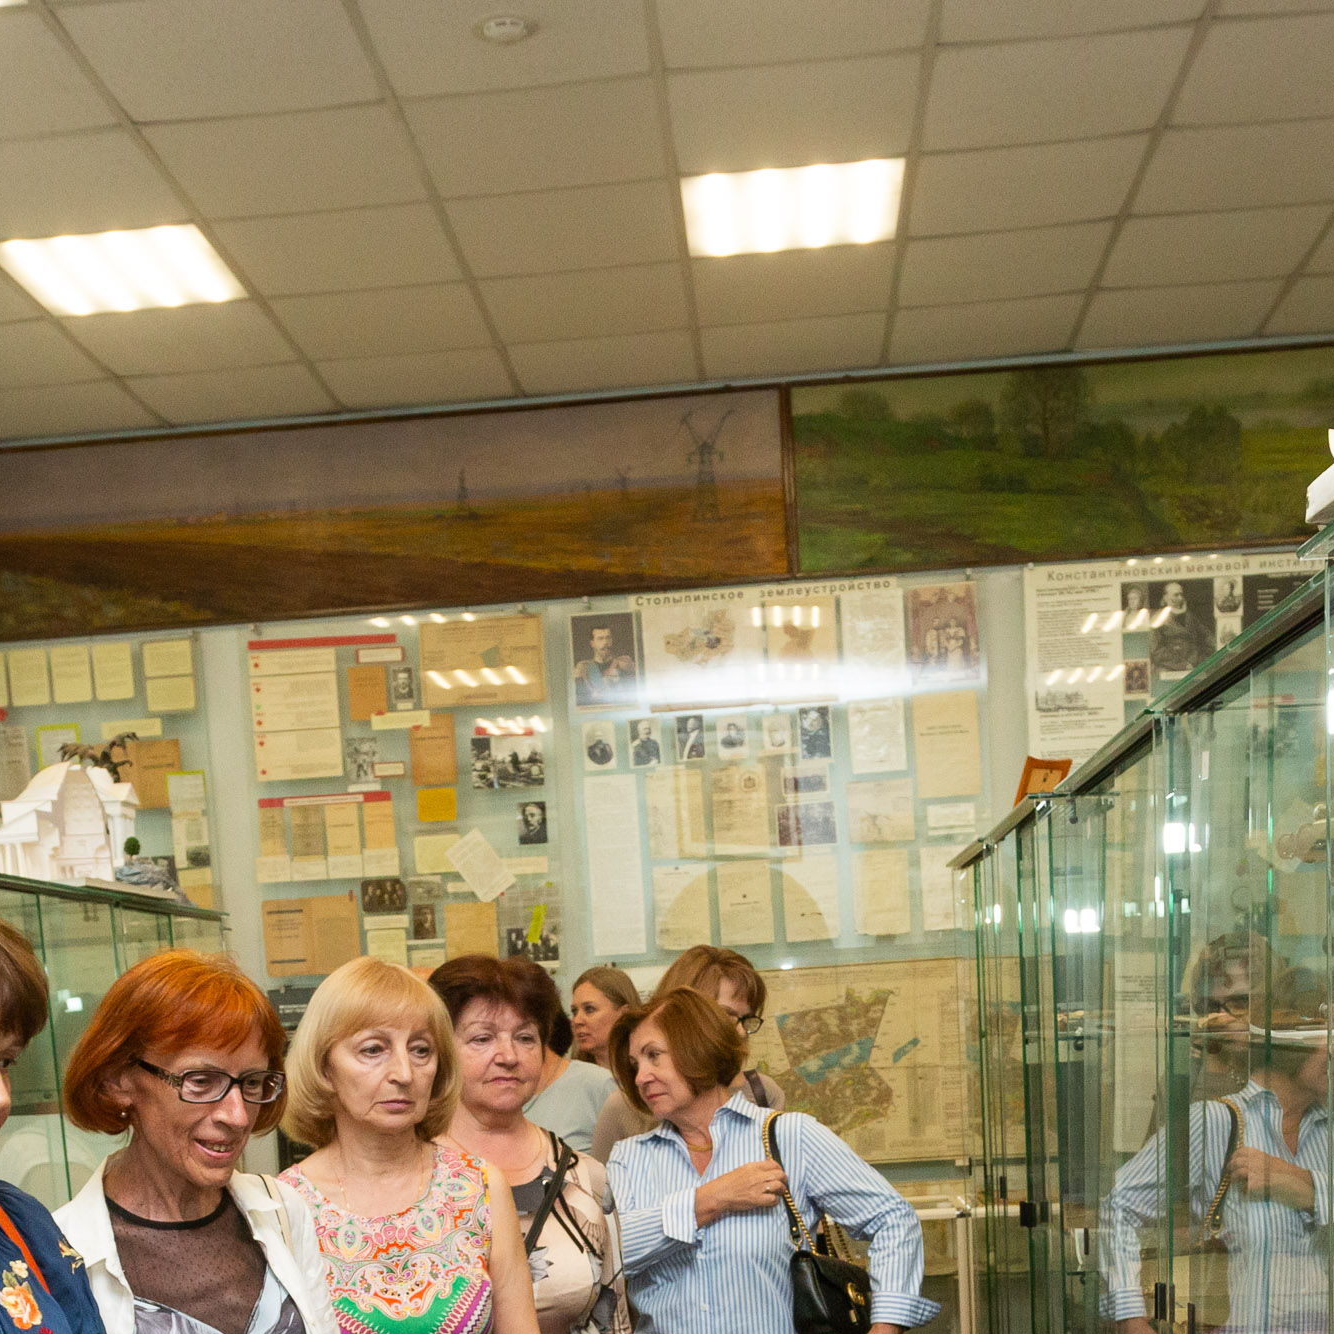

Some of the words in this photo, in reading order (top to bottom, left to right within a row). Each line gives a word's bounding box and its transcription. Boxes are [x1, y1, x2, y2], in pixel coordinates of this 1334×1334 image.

[1047, 565, 1182, 581] Константиновский
[1187, 559, 1250, 573] межевой
[635, 589, 744, 606] Столыпинское
[759, 579, 891, 598] землеустройство
